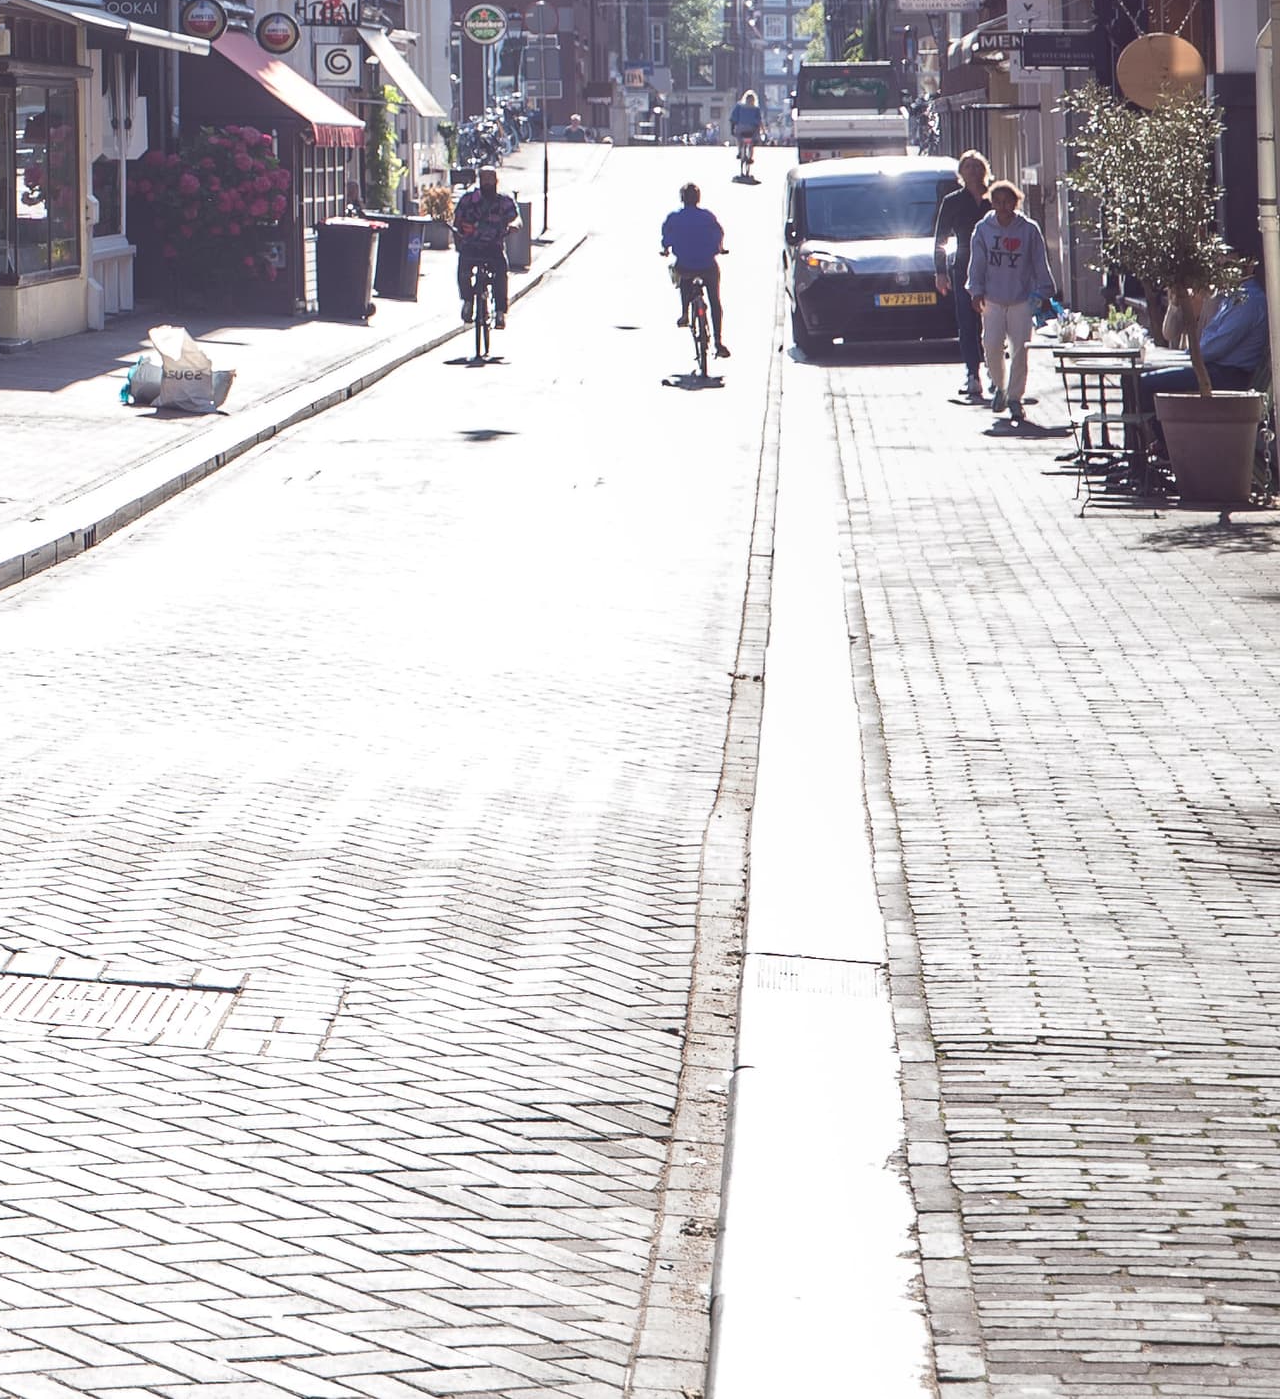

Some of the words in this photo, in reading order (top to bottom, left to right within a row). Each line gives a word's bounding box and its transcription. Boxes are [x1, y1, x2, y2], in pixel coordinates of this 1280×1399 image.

[103, 1, 158, 15] OOKAI
[993, 236, 1001, 250] I
[991, 253, 1022, 268] NY
